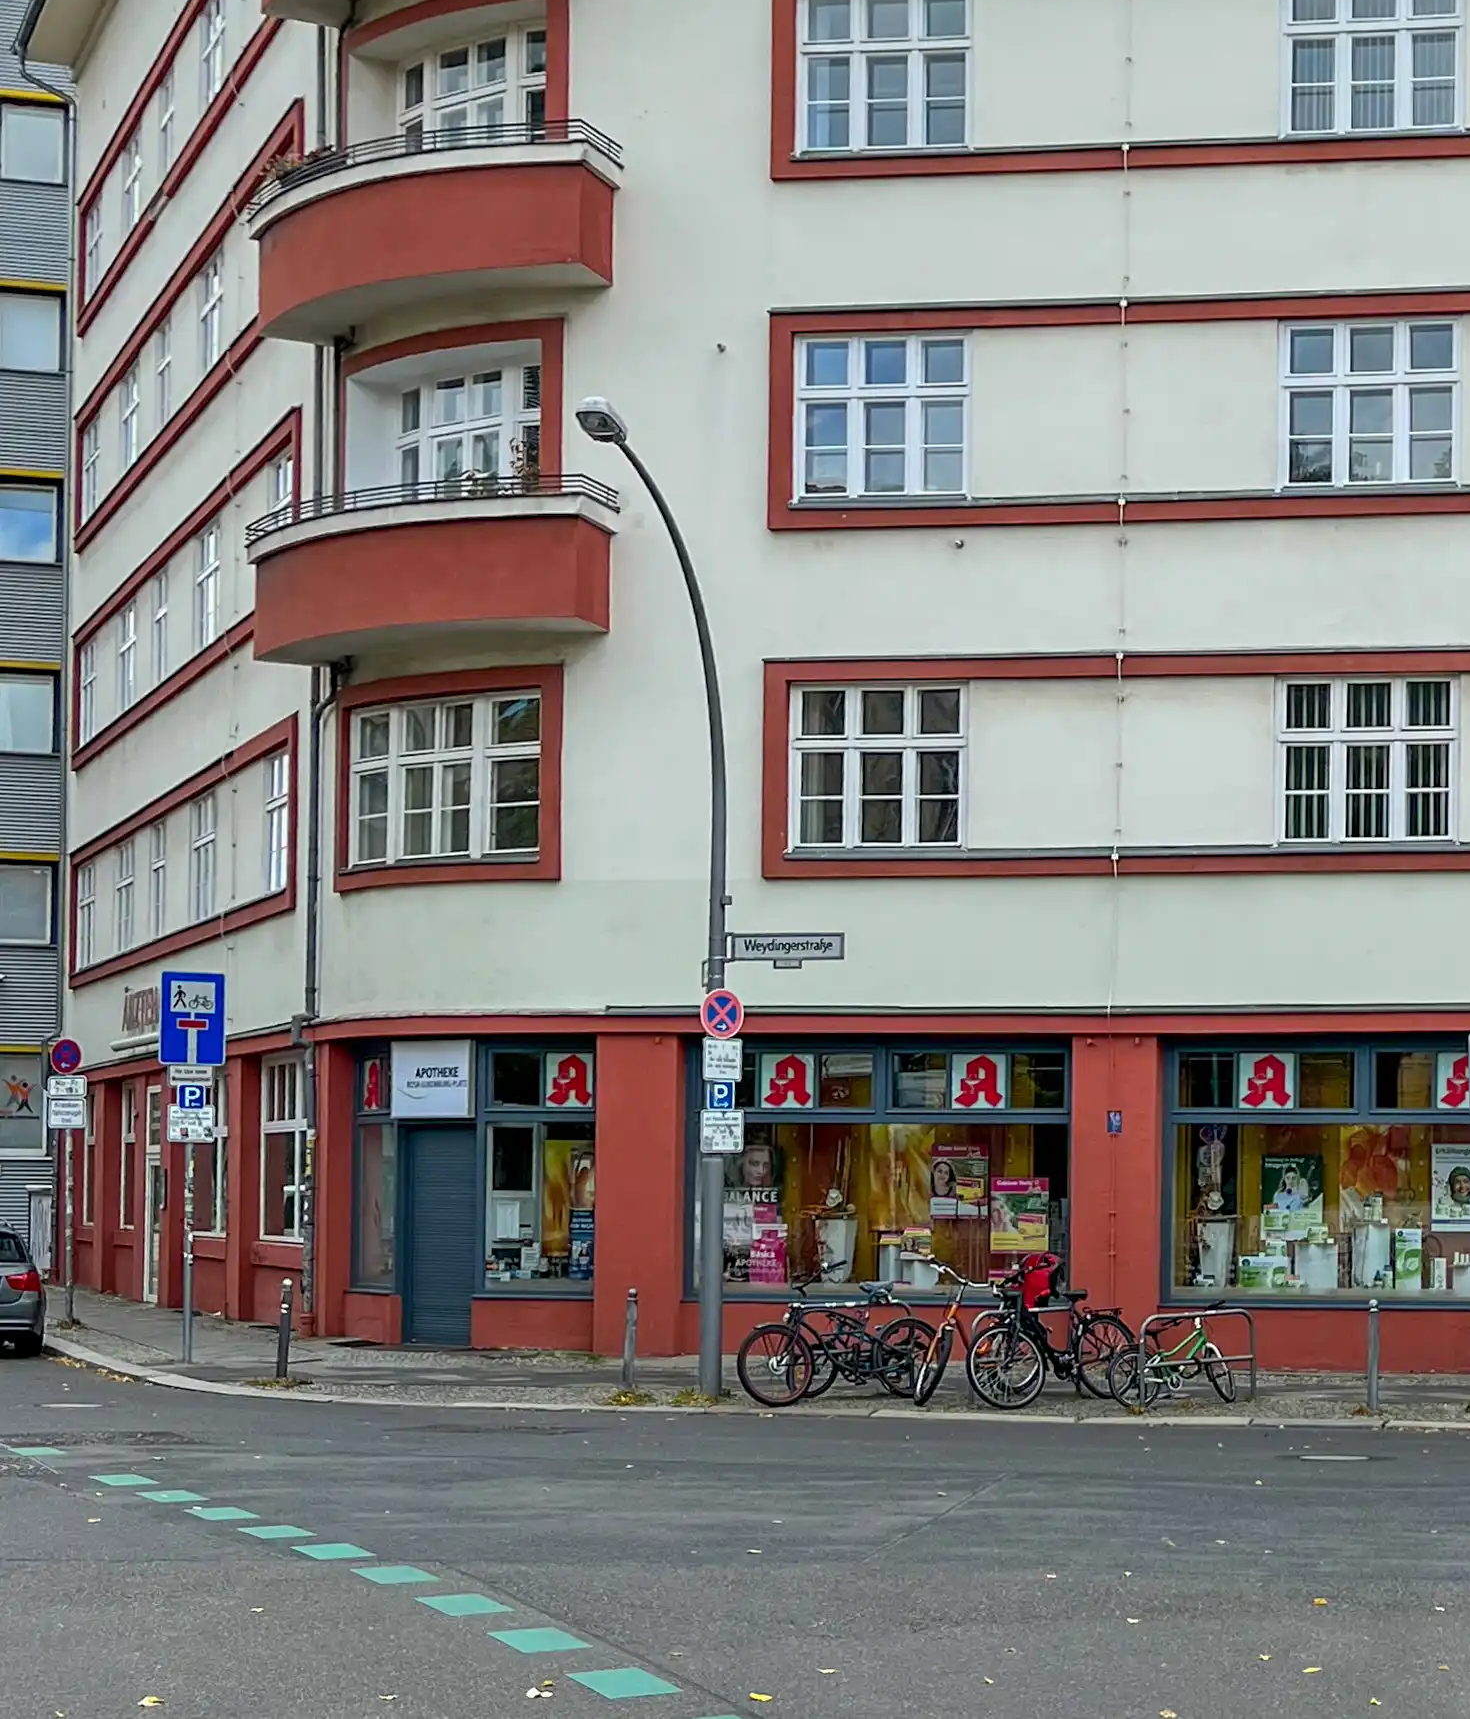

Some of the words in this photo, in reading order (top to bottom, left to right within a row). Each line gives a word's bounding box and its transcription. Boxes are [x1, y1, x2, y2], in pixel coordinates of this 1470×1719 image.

[743, 938, 833, 954] Weydingerstraße
[415, 1066, 460, 1078] APOTHEKE
[184, 1086, 201, 1107] P
[713, 1083, 728, 1107] P
